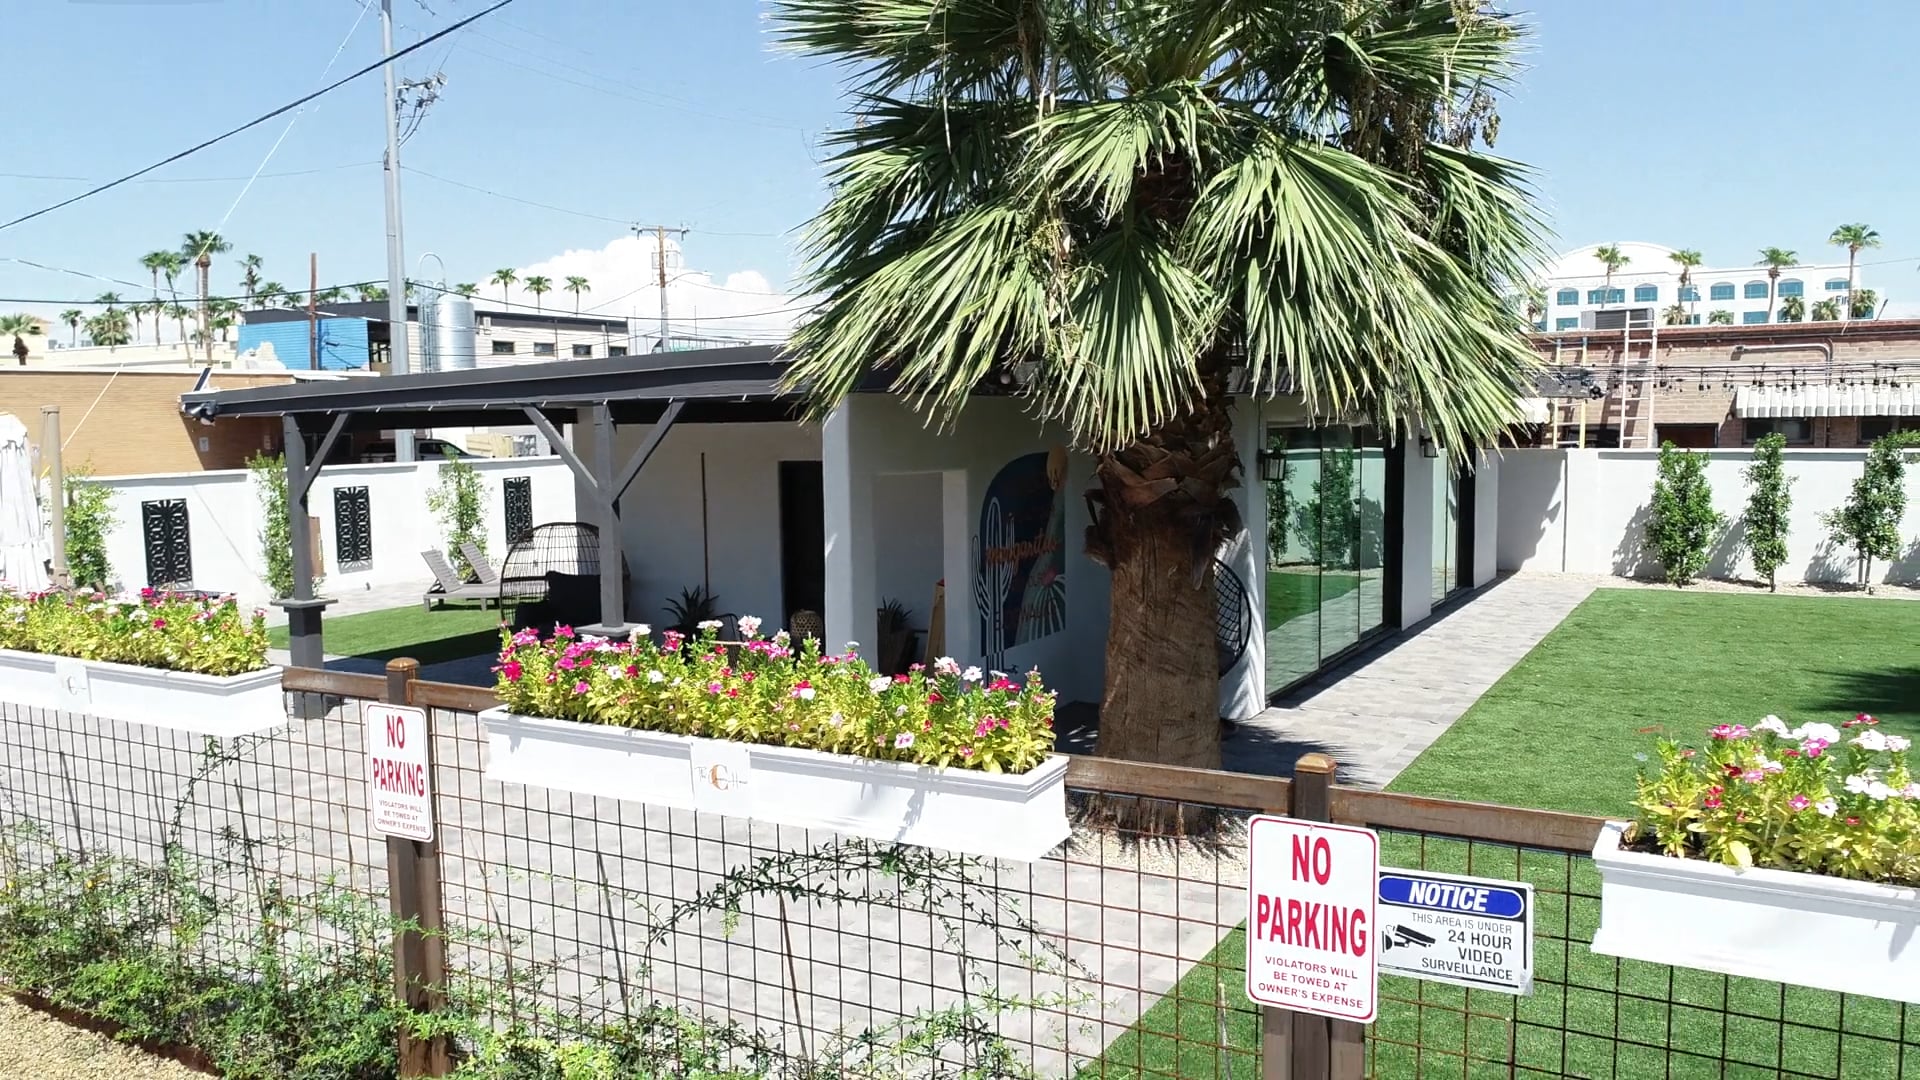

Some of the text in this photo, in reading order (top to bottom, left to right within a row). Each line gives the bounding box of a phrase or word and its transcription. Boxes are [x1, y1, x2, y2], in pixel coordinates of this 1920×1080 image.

[386, 714, 406, 749] NO
[372, 757, 425, 798] PARKING
[379, 799, 423, 813] VIOLATORS WILL
[383, 809, 391, 817] BE
[392, 811, 411, 821] TOWED
[377, 817, 427, 834] OWNER'S EXPENSE
[1292, 833, 1332, 886] NO
[1408, 881, 1490, 912] NOTICE
[1257, 893, 1367, 958] PARKING
[1412, 912, 1512, 935] THIS AREA IS UNDER
[1448, 929, 1512, 951] 24 HOUR
[1265, 955, 1358, 980] VIOLATORS WILL
[1458, 946, 1503, 966] VIDEO
[1273, 970, 1348, 992] BE TOWED AT
[1421, 957, 1513, 981] SURVEILLANCE
[1258, 982, 1364, 1009] OWNER'S EXPENSE
